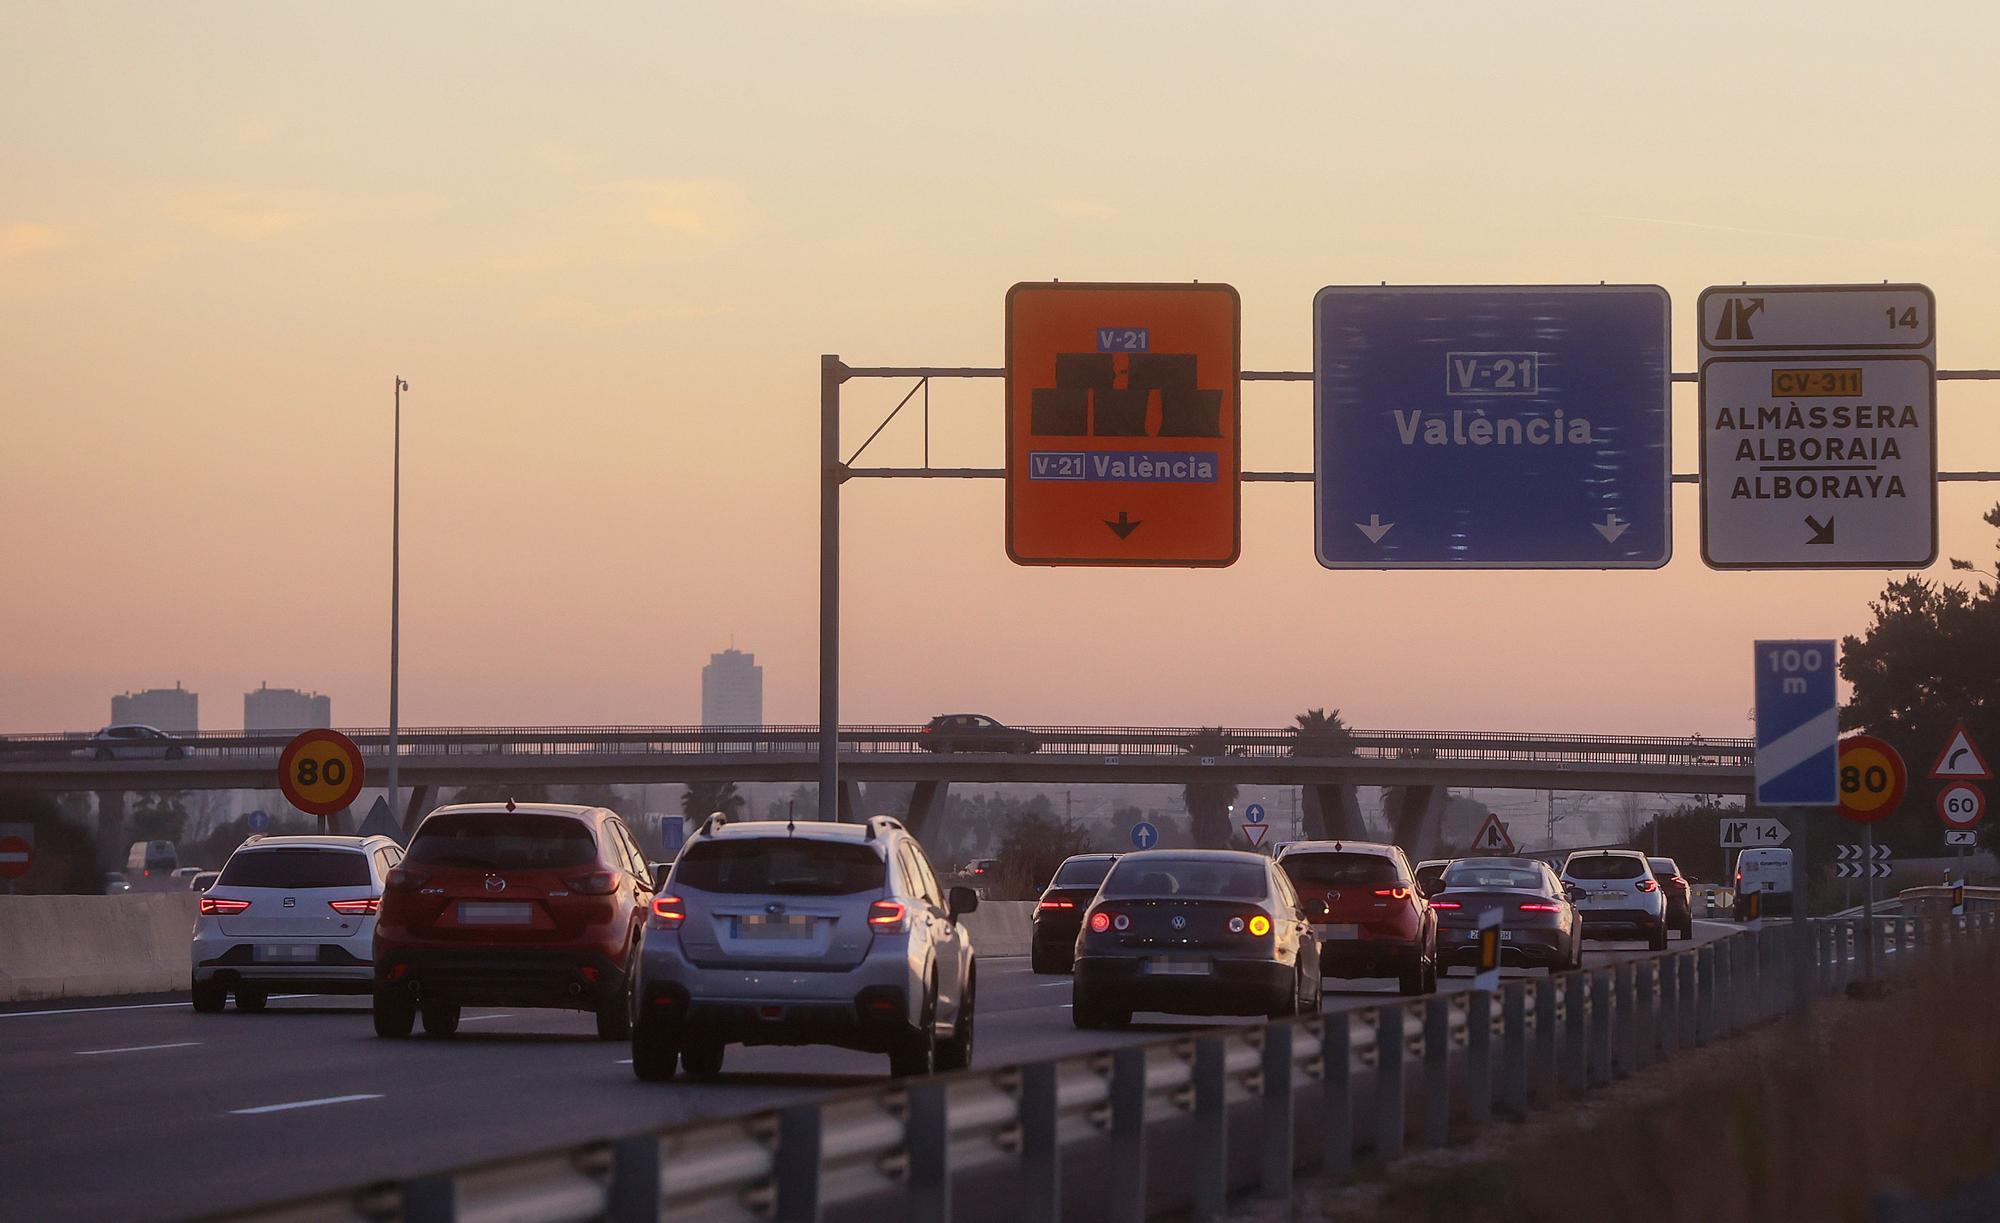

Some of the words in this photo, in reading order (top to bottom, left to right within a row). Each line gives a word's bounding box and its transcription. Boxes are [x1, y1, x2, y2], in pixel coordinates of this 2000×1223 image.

[1886, 306, 1919, 330] 14
[1100, 330, 1147, 349] V-21
[1454, 359, 1531, 388] V-21
[1776, 373, 1858, 392] CV-311
[1394, 408, 1592, 445] València
[1715, 401, 1919, 430] ALMÀSSERA
[1735, 437, 1902, 461] ALBORAIA
[1035, 457, 1082, 475] V-21
[1093, 455, 1213, 478] València
[1731, 475, 1906, 499] ALBORAYA
[1768, 649, 1822, 672] 100
[1783, 677, 1807, 694] m
[297, 758, 346, 786] 80
[1840, 765, 1887, 793] 80
[1948, 798, 1974, 814] 60
[1754, 825, 1778, 840] 14
